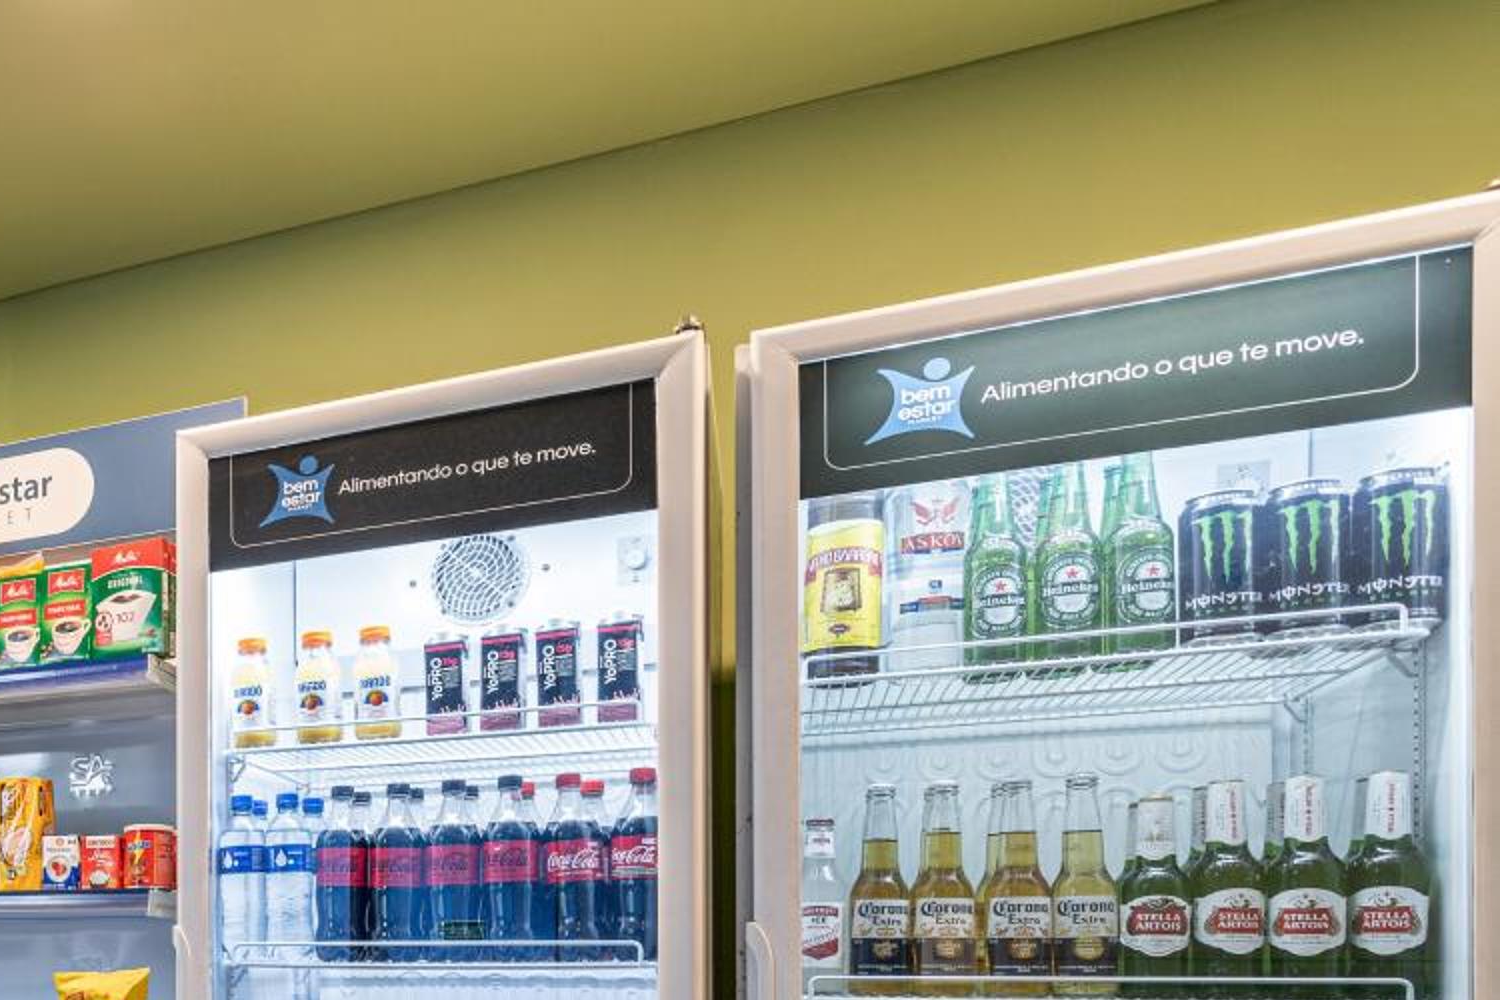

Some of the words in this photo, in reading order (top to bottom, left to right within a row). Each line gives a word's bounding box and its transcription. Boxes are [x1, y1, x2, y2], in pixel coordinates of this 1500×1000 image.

[981, 362, 1148, 404] Alimentando
[1155, 360, 1172, 375] o
[1179, 350, 1233, 374] que
[1239, 343, 1269, 362] te
[1275, 330, 1364, 356] move.
[901, 385, 950, 404] bem
[898, 400, 956, 421] estar
[339, 464, 452, 495] Alimentando
[456, 463, 468, 475] o
[472, 456, 509, 476] que
[514, 451, 533, 466] te
[537, 442, 596, 462] move.
[283, 480, 318, 495] bem
[282, 491, 321, 508] estar
[542, 645, 556, 690] YoPRO
[604, 639, 617, 684] YoPRO
[430, 657, 443, 701] YoPRO
[487, 651, 499, 695] YoPRO
[1057, 900, 1115, 917] Corona
[1136, 913, 1181, 921] STELLA
[1218, 912, 1259, 920] STELLA
[1283, 913, 1330, 921] STELLA
[1362, 911, 1410, 920] STELLA
